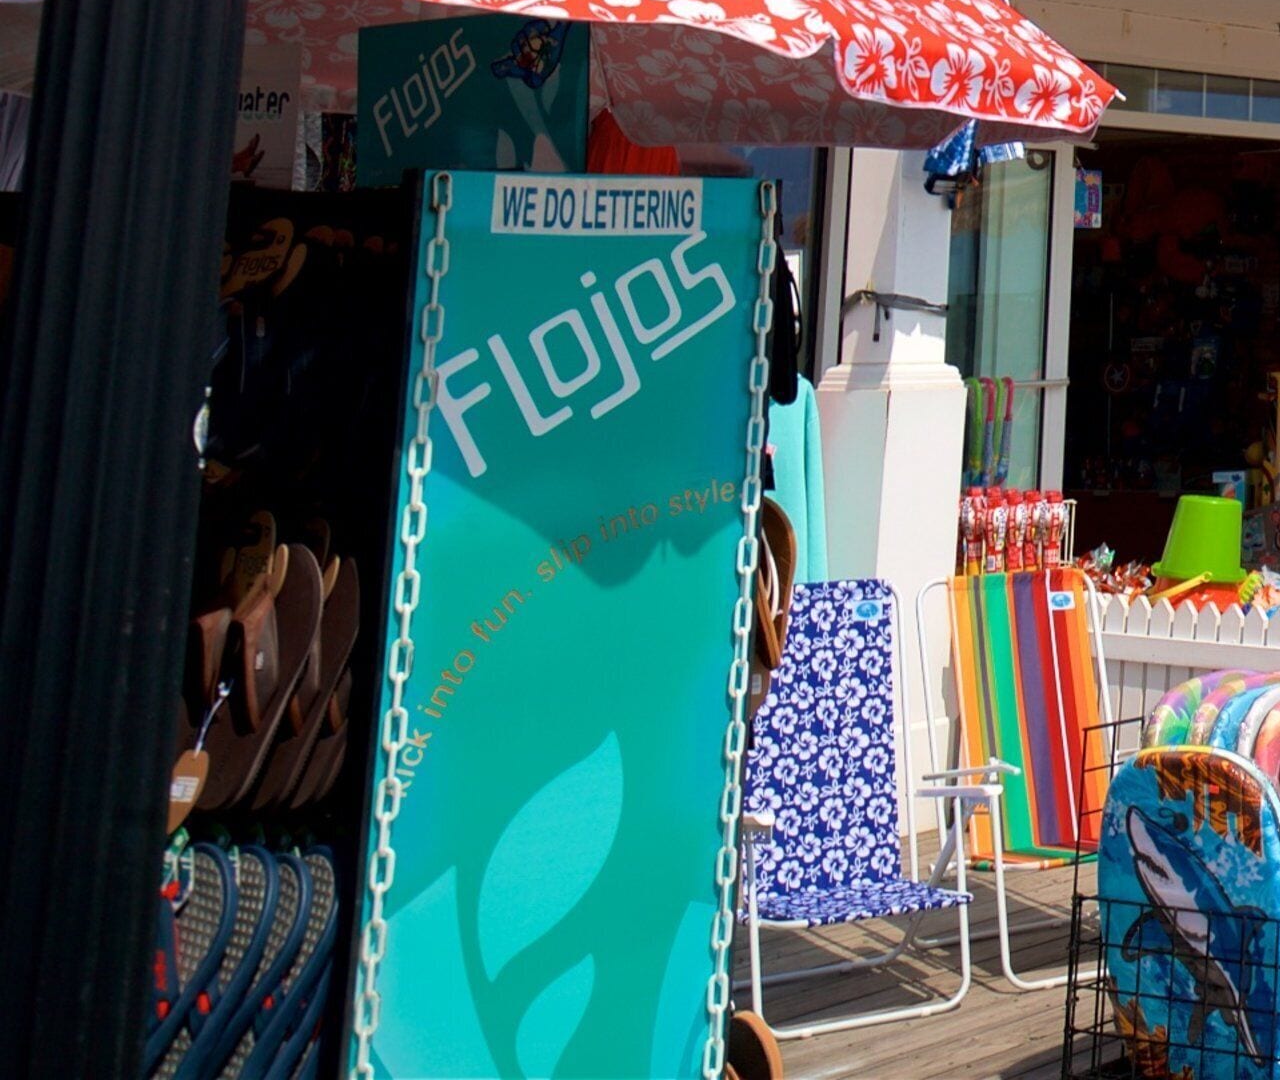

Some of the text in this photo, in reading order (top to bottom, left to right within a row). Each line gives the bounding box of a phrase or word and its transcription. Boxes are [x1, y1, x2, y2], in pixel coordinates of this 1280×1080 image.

[238, 86, 290, 114] ater
[372, 27, 477, 158] Flojos
[503, 186, 696, 230] WE DO LETTERING
[433, 230, 737, 479] Flojos
[417, 650, 475, 719] into
[536, 533, 593, 584] slip
[600, 502, 658, 543] into
